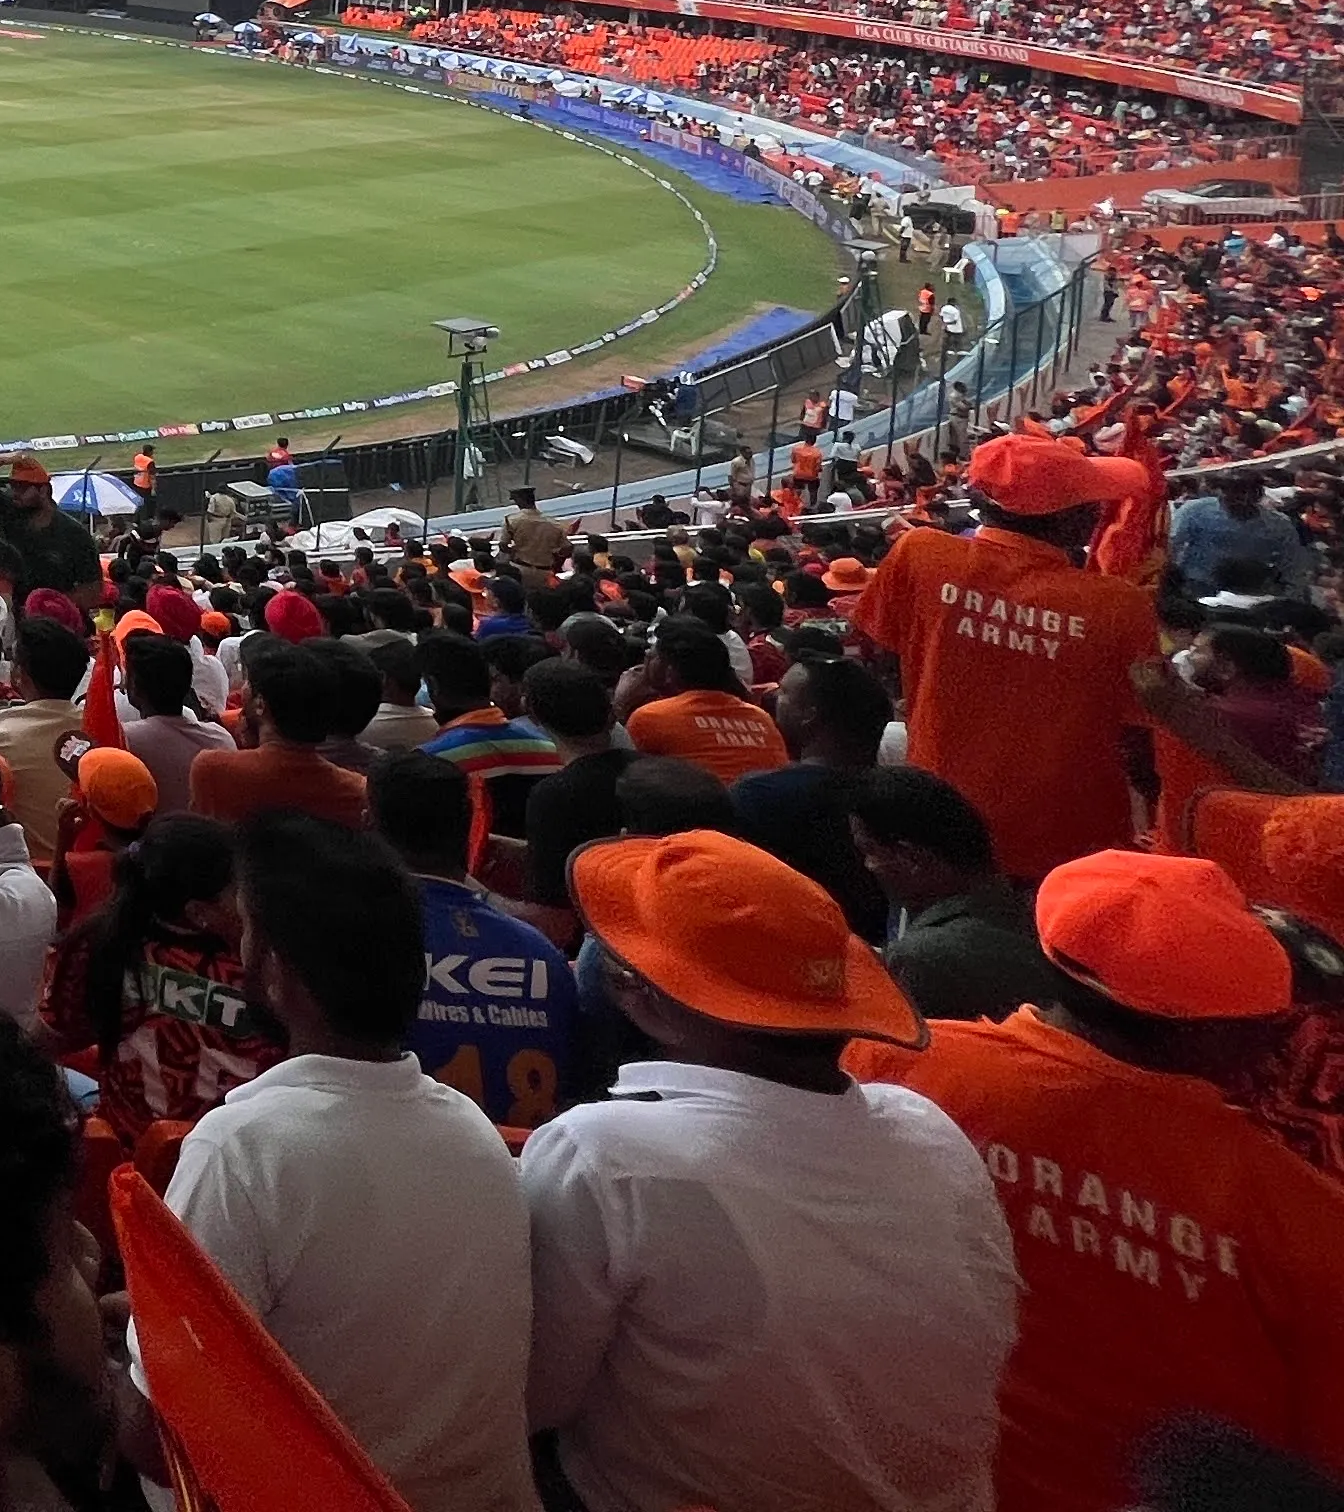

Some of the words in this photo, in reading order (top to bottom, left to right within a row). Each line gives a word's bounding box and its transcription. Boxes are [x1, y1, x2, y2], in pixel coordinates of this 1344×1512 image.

[855, 25, 879, 39] HCA
[882, 28, 911, 44] CLUB
[914, 32, 987, 55] SECRETARIES
[989, 42, 1028, 62] STAND
[490, 83, 520, 98] KOTA
[941, 583, 1086, 639] ORANGE
[956, 617, 1060, 660] ARMY
[694, 715, 769, 734] ORANGE
[714, 732, 766, 748] ARMY
[423, 952, 549, 1000] KEI
[472, 1006, 486, 1025] &
[487, 1003, 548, 1028] Cables
[987, 1144, 1240, 1281] ORANGE
[1028, 1204, 1208, 1302] ARMY
